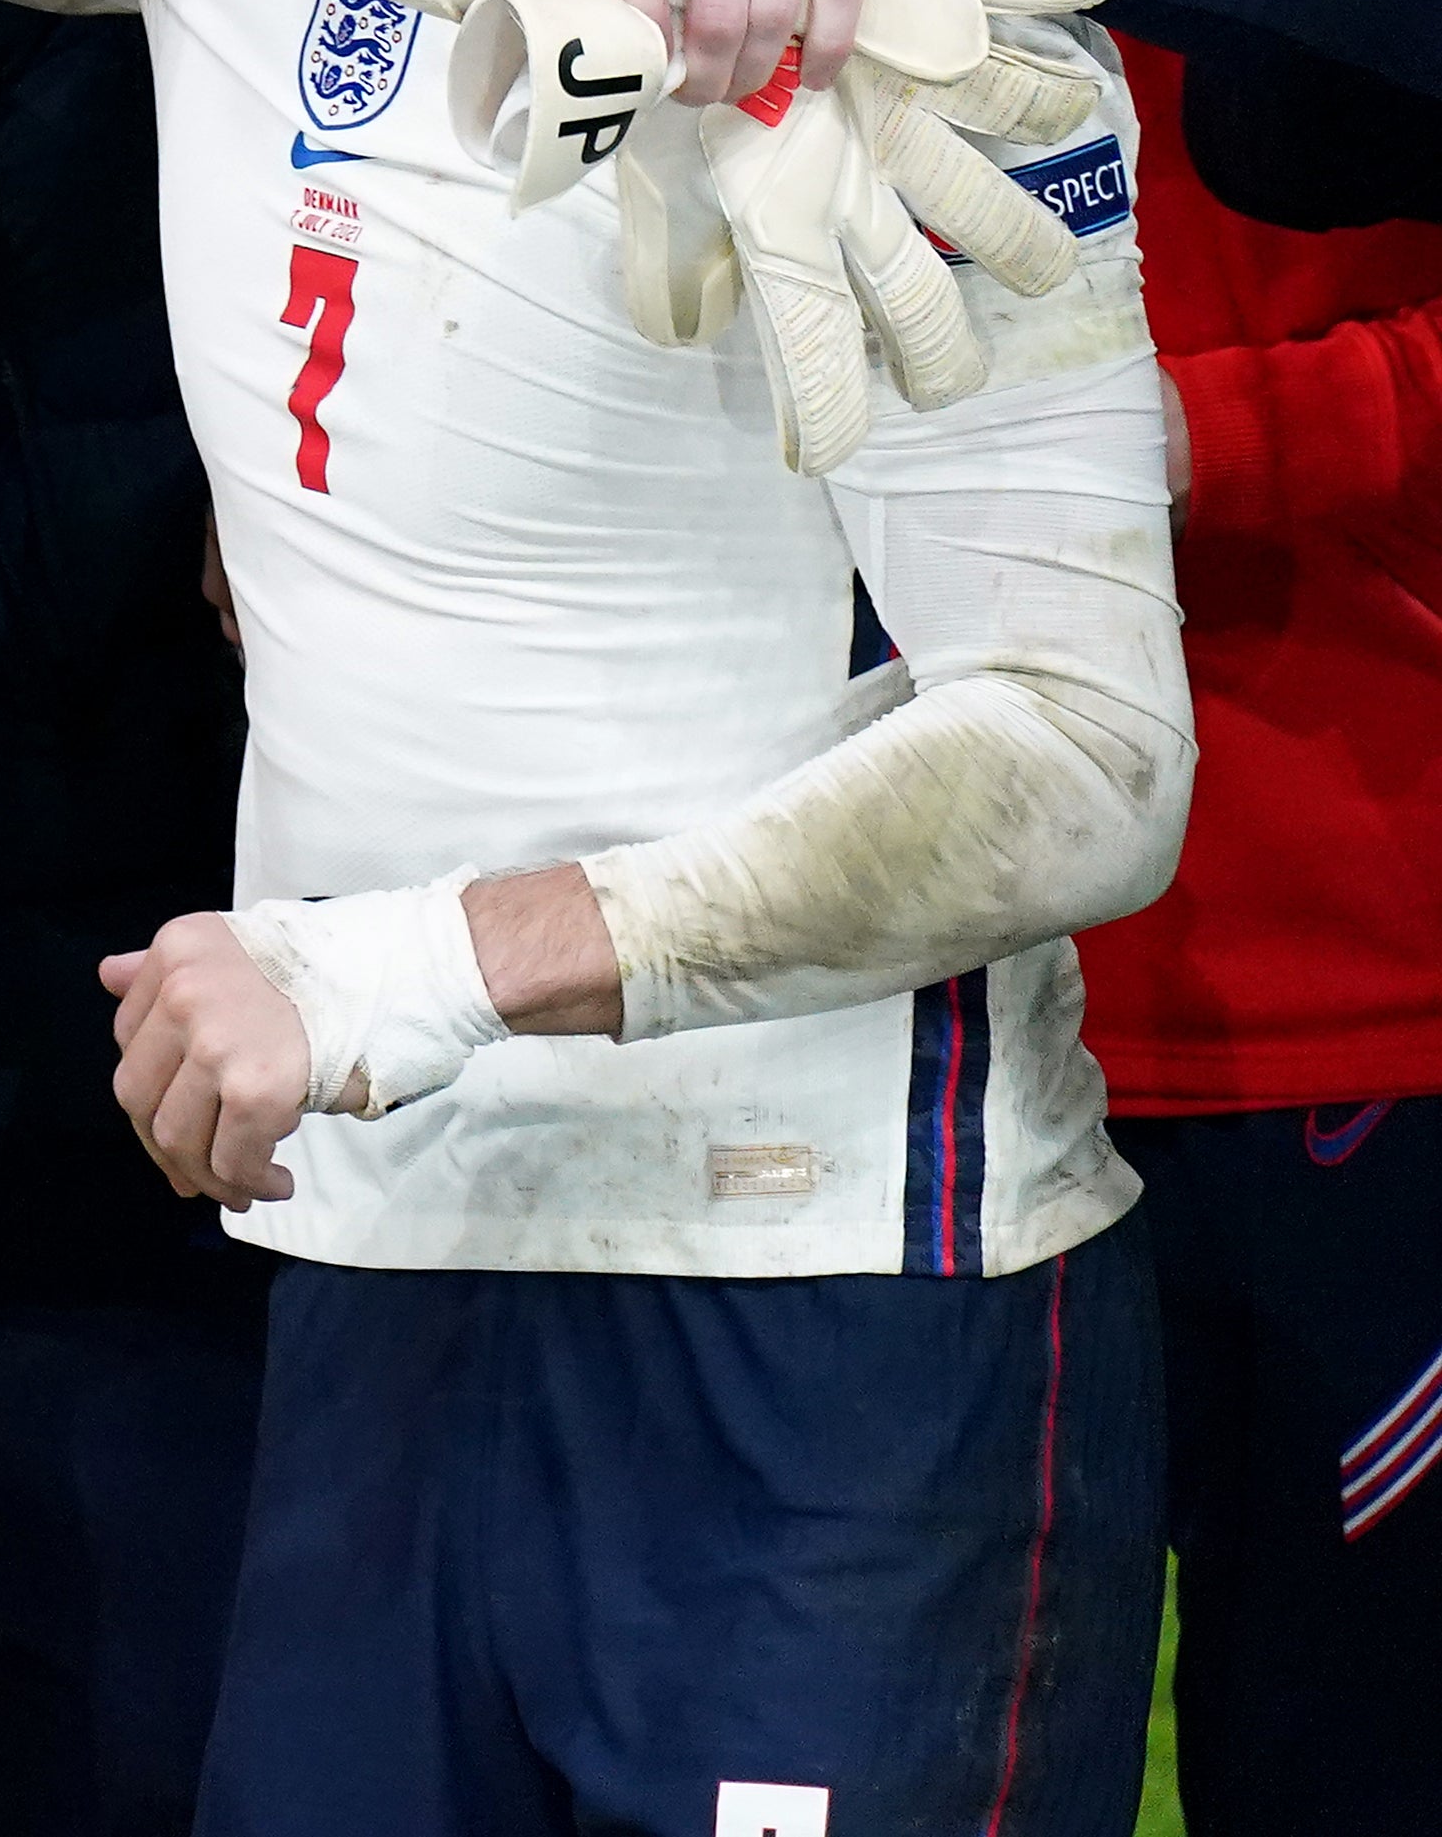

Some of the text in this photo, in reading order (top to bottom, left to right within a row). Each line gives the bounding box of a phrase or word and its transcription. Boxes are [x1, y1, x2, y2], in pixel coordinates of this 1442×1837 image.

[558, 37, 643, 164] JP
[303, 187, 361, 221] DENMARK
[1031, 160, 1123, 216] SPECT
[291, 209, 301, 227] 7
[279, 243, 360, 496] 7
